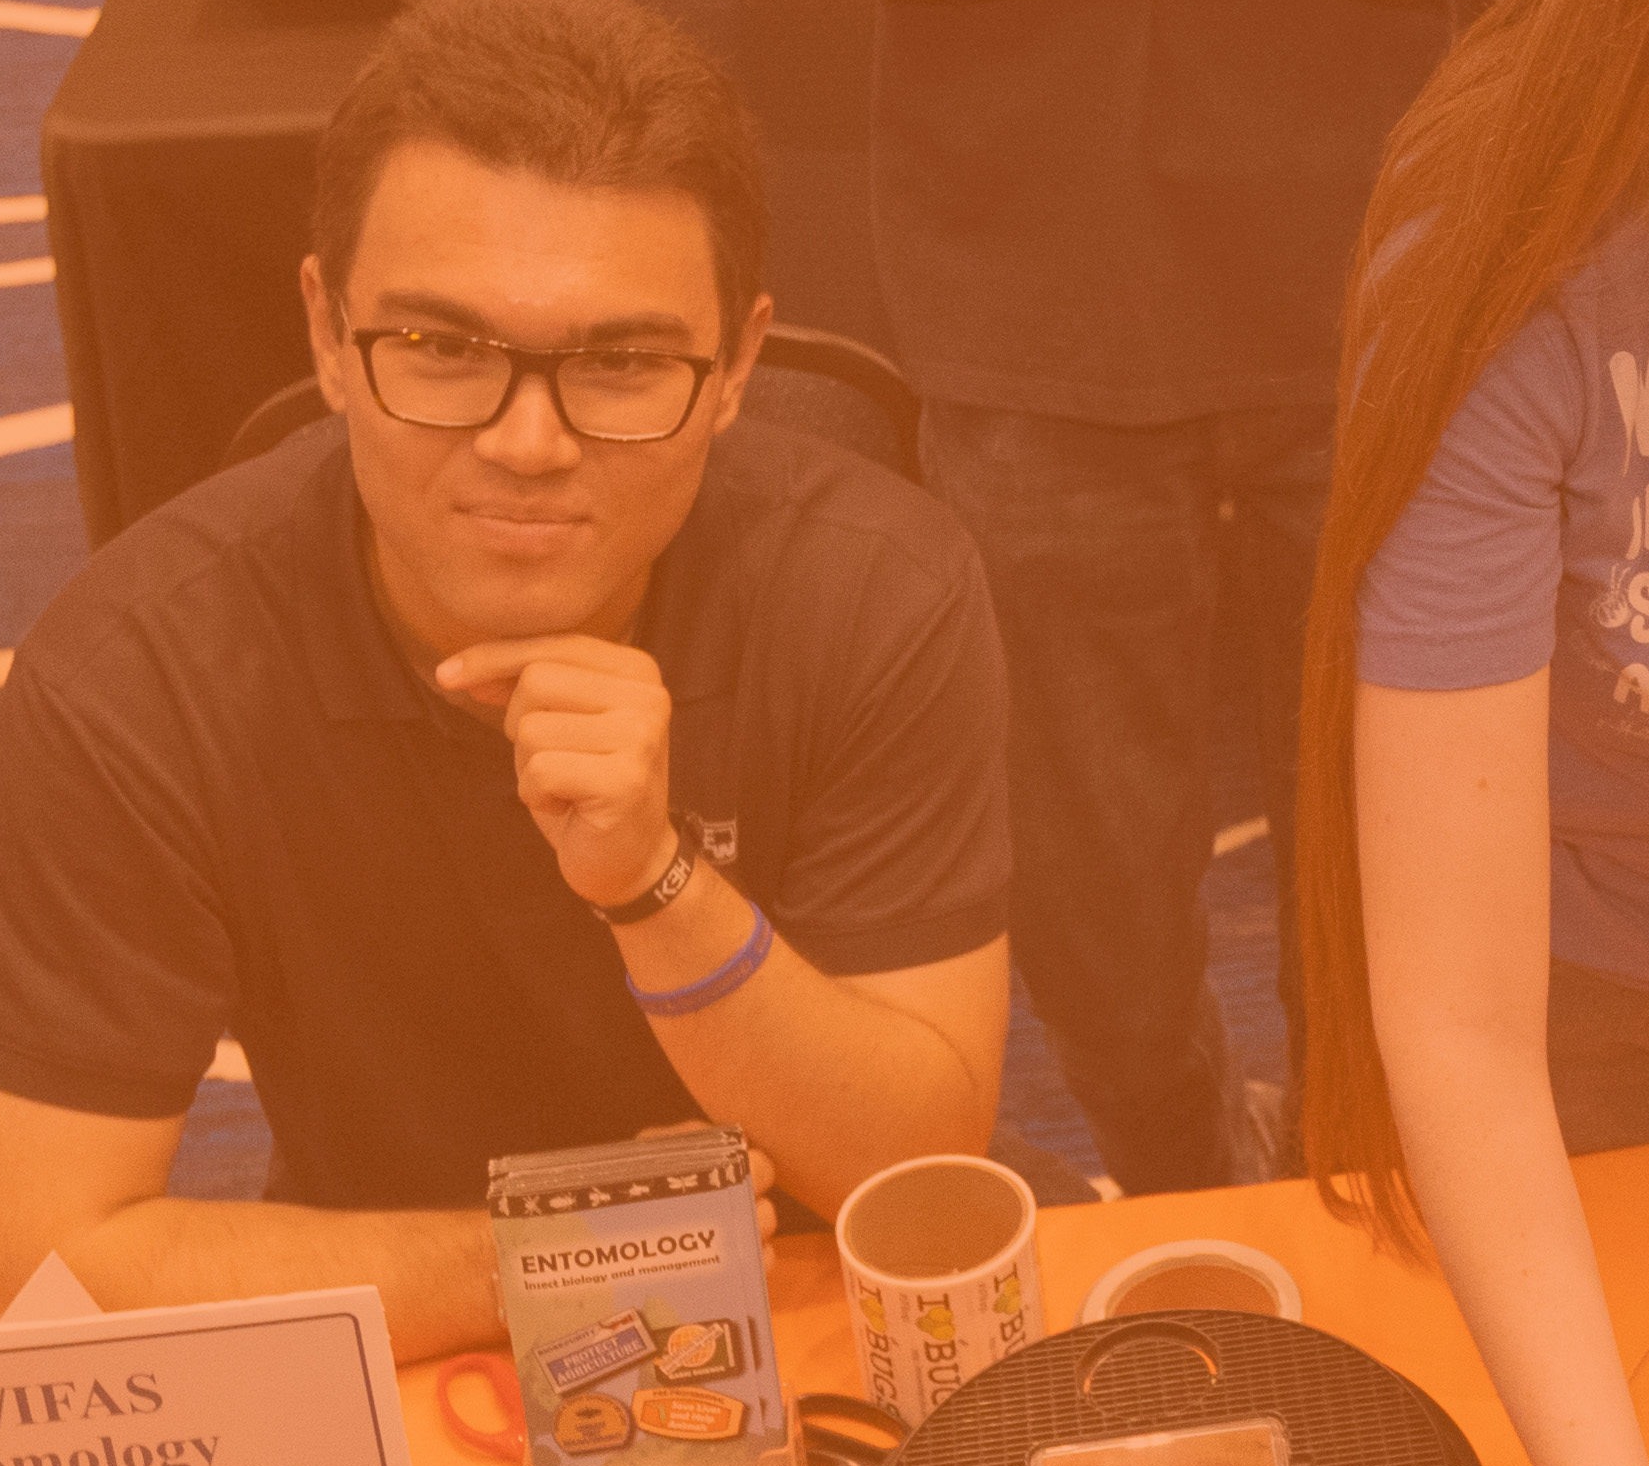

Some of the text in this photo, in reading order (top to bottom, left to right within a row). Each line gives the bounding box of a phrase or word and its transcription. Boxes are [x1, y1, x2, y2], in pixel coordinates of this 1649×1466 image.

[520, 1228, 717, 1276] ENTOMOLOGY
[523, 1254, 722, 1292] Insect biology and management
[556, 1339, 643, 1384] AGRICULTURE
[562, 1336, 620, 1368] PROTECT
